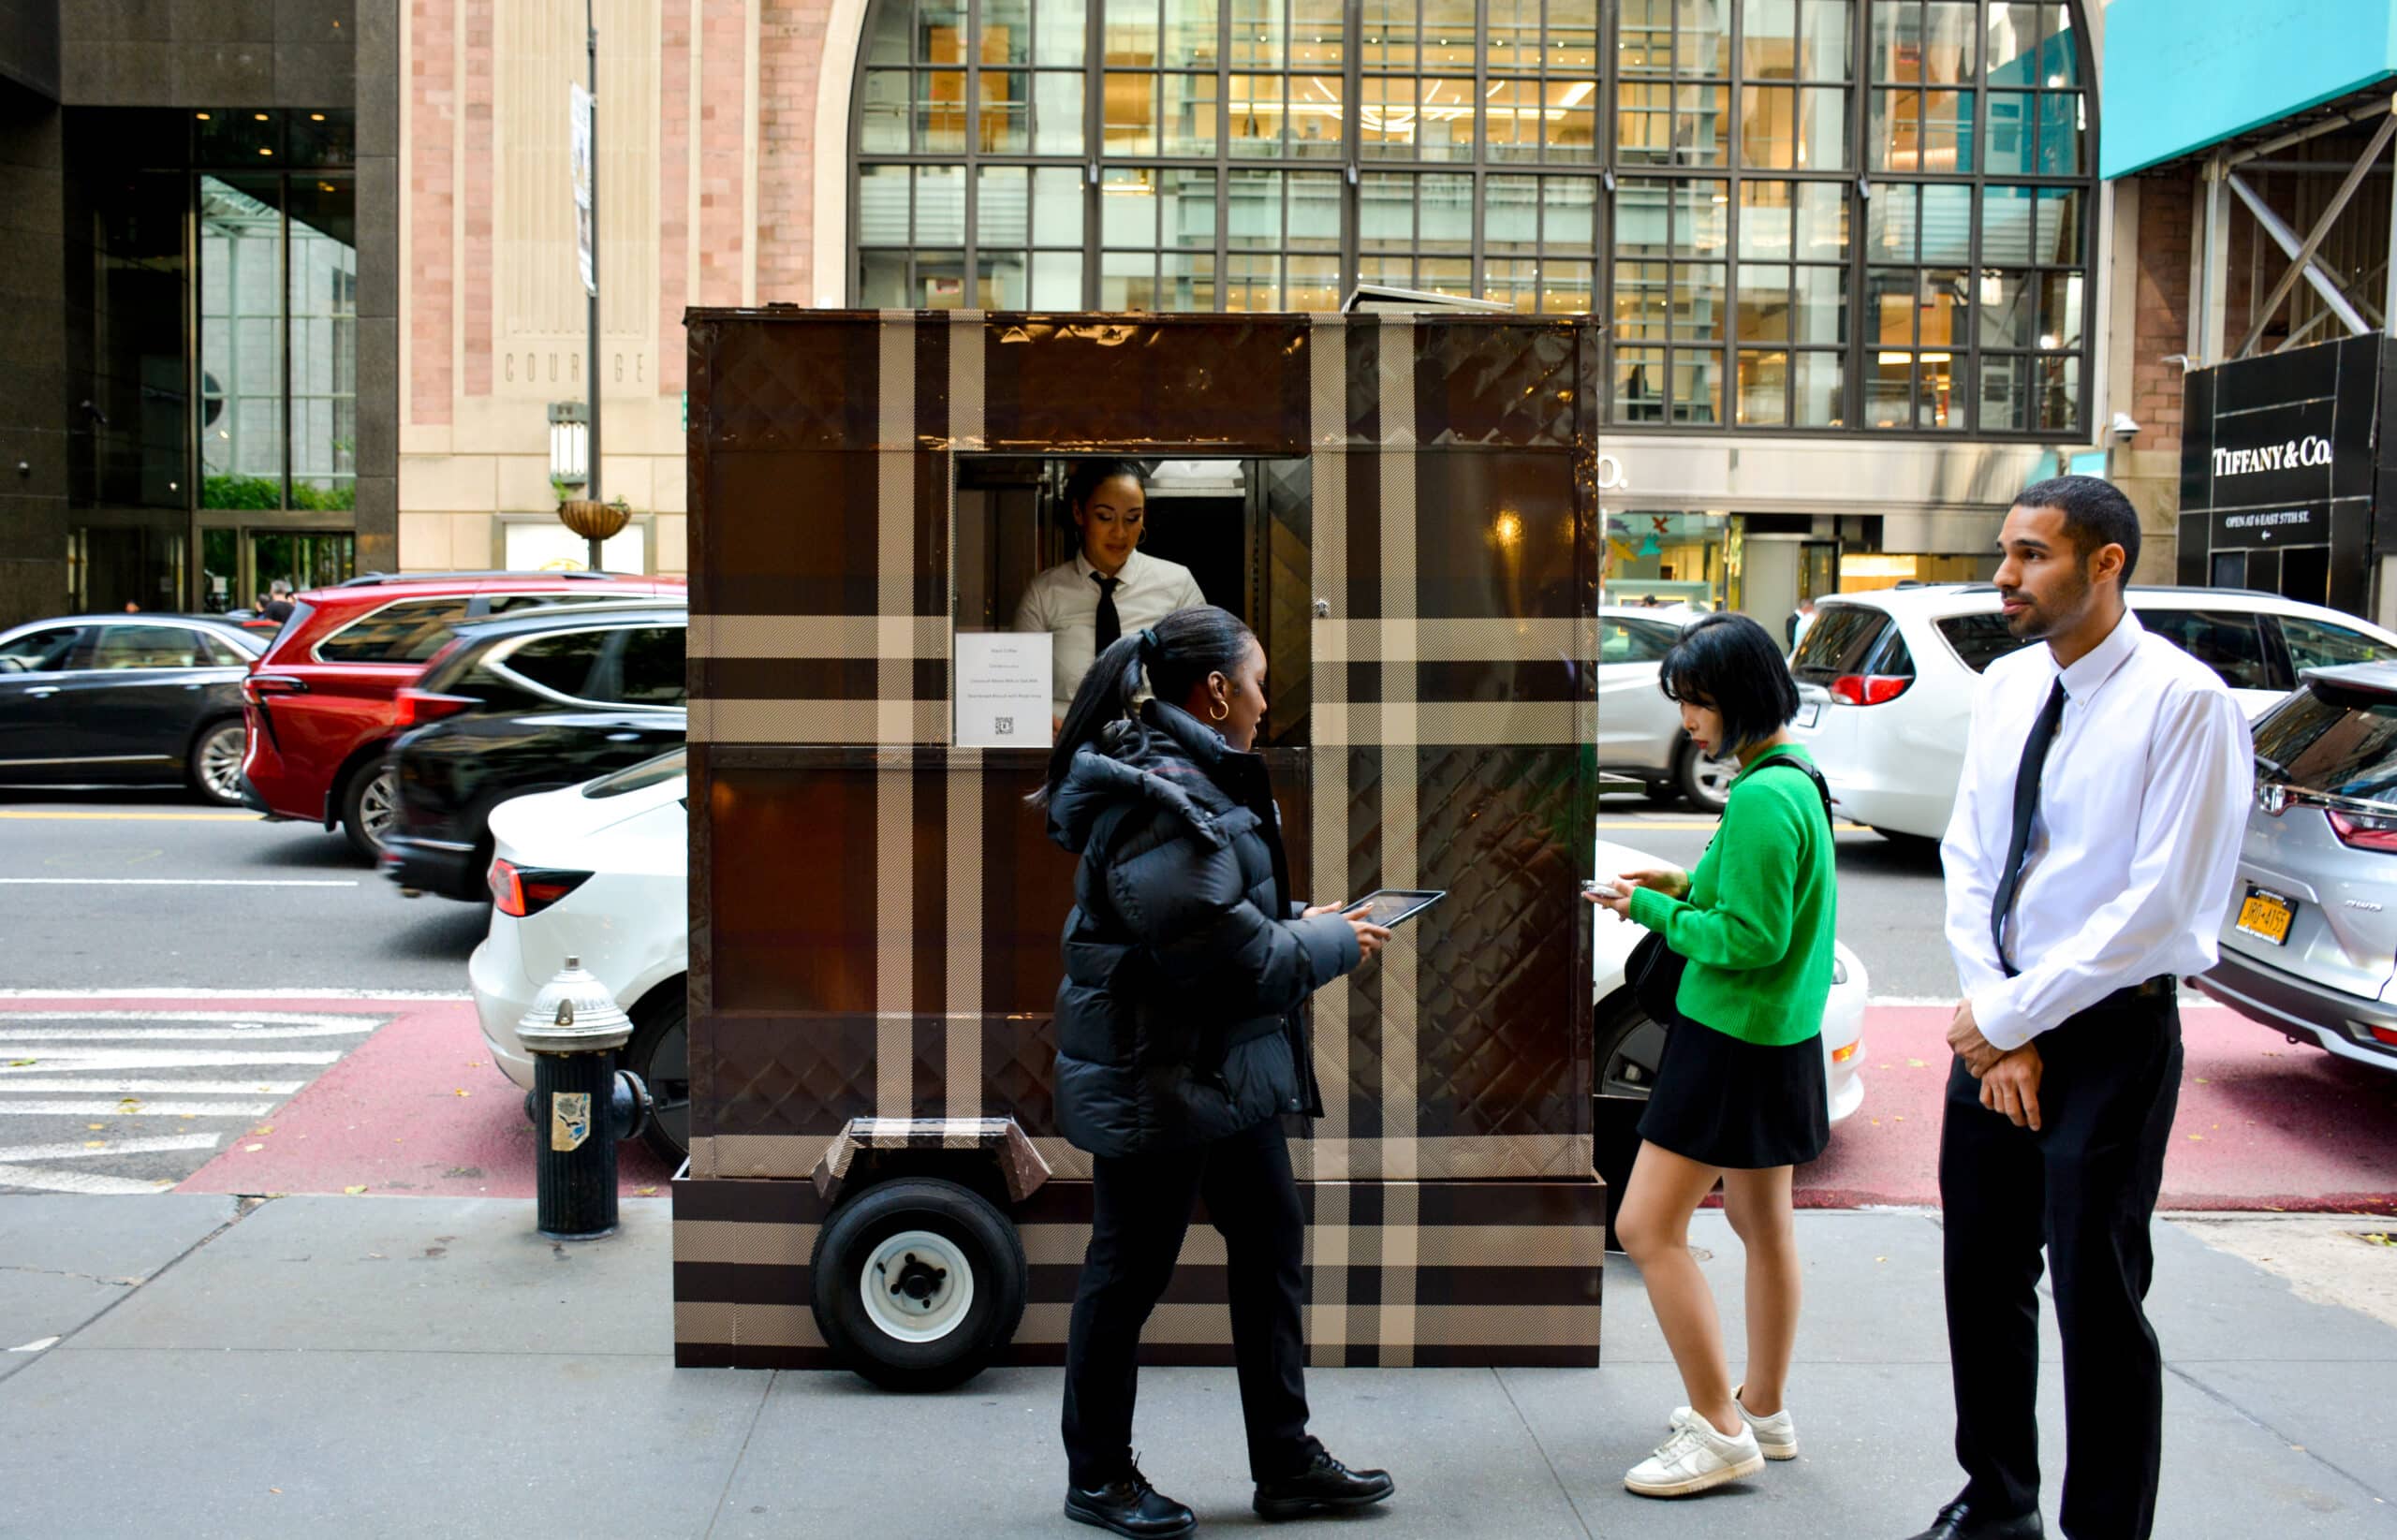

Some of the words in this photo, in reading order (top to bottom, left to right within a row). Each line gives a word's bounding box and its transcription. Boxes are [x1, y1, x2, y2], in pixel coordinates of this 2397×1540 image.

[505, 352, 643, 383] COURGE
[2226, 516, 2244, 529] OPEN
[2245, 515, 2255, 527] AT
[2260, 512, 2279, 526] EAST
[2279, 511, 2298, 524] 57TH
